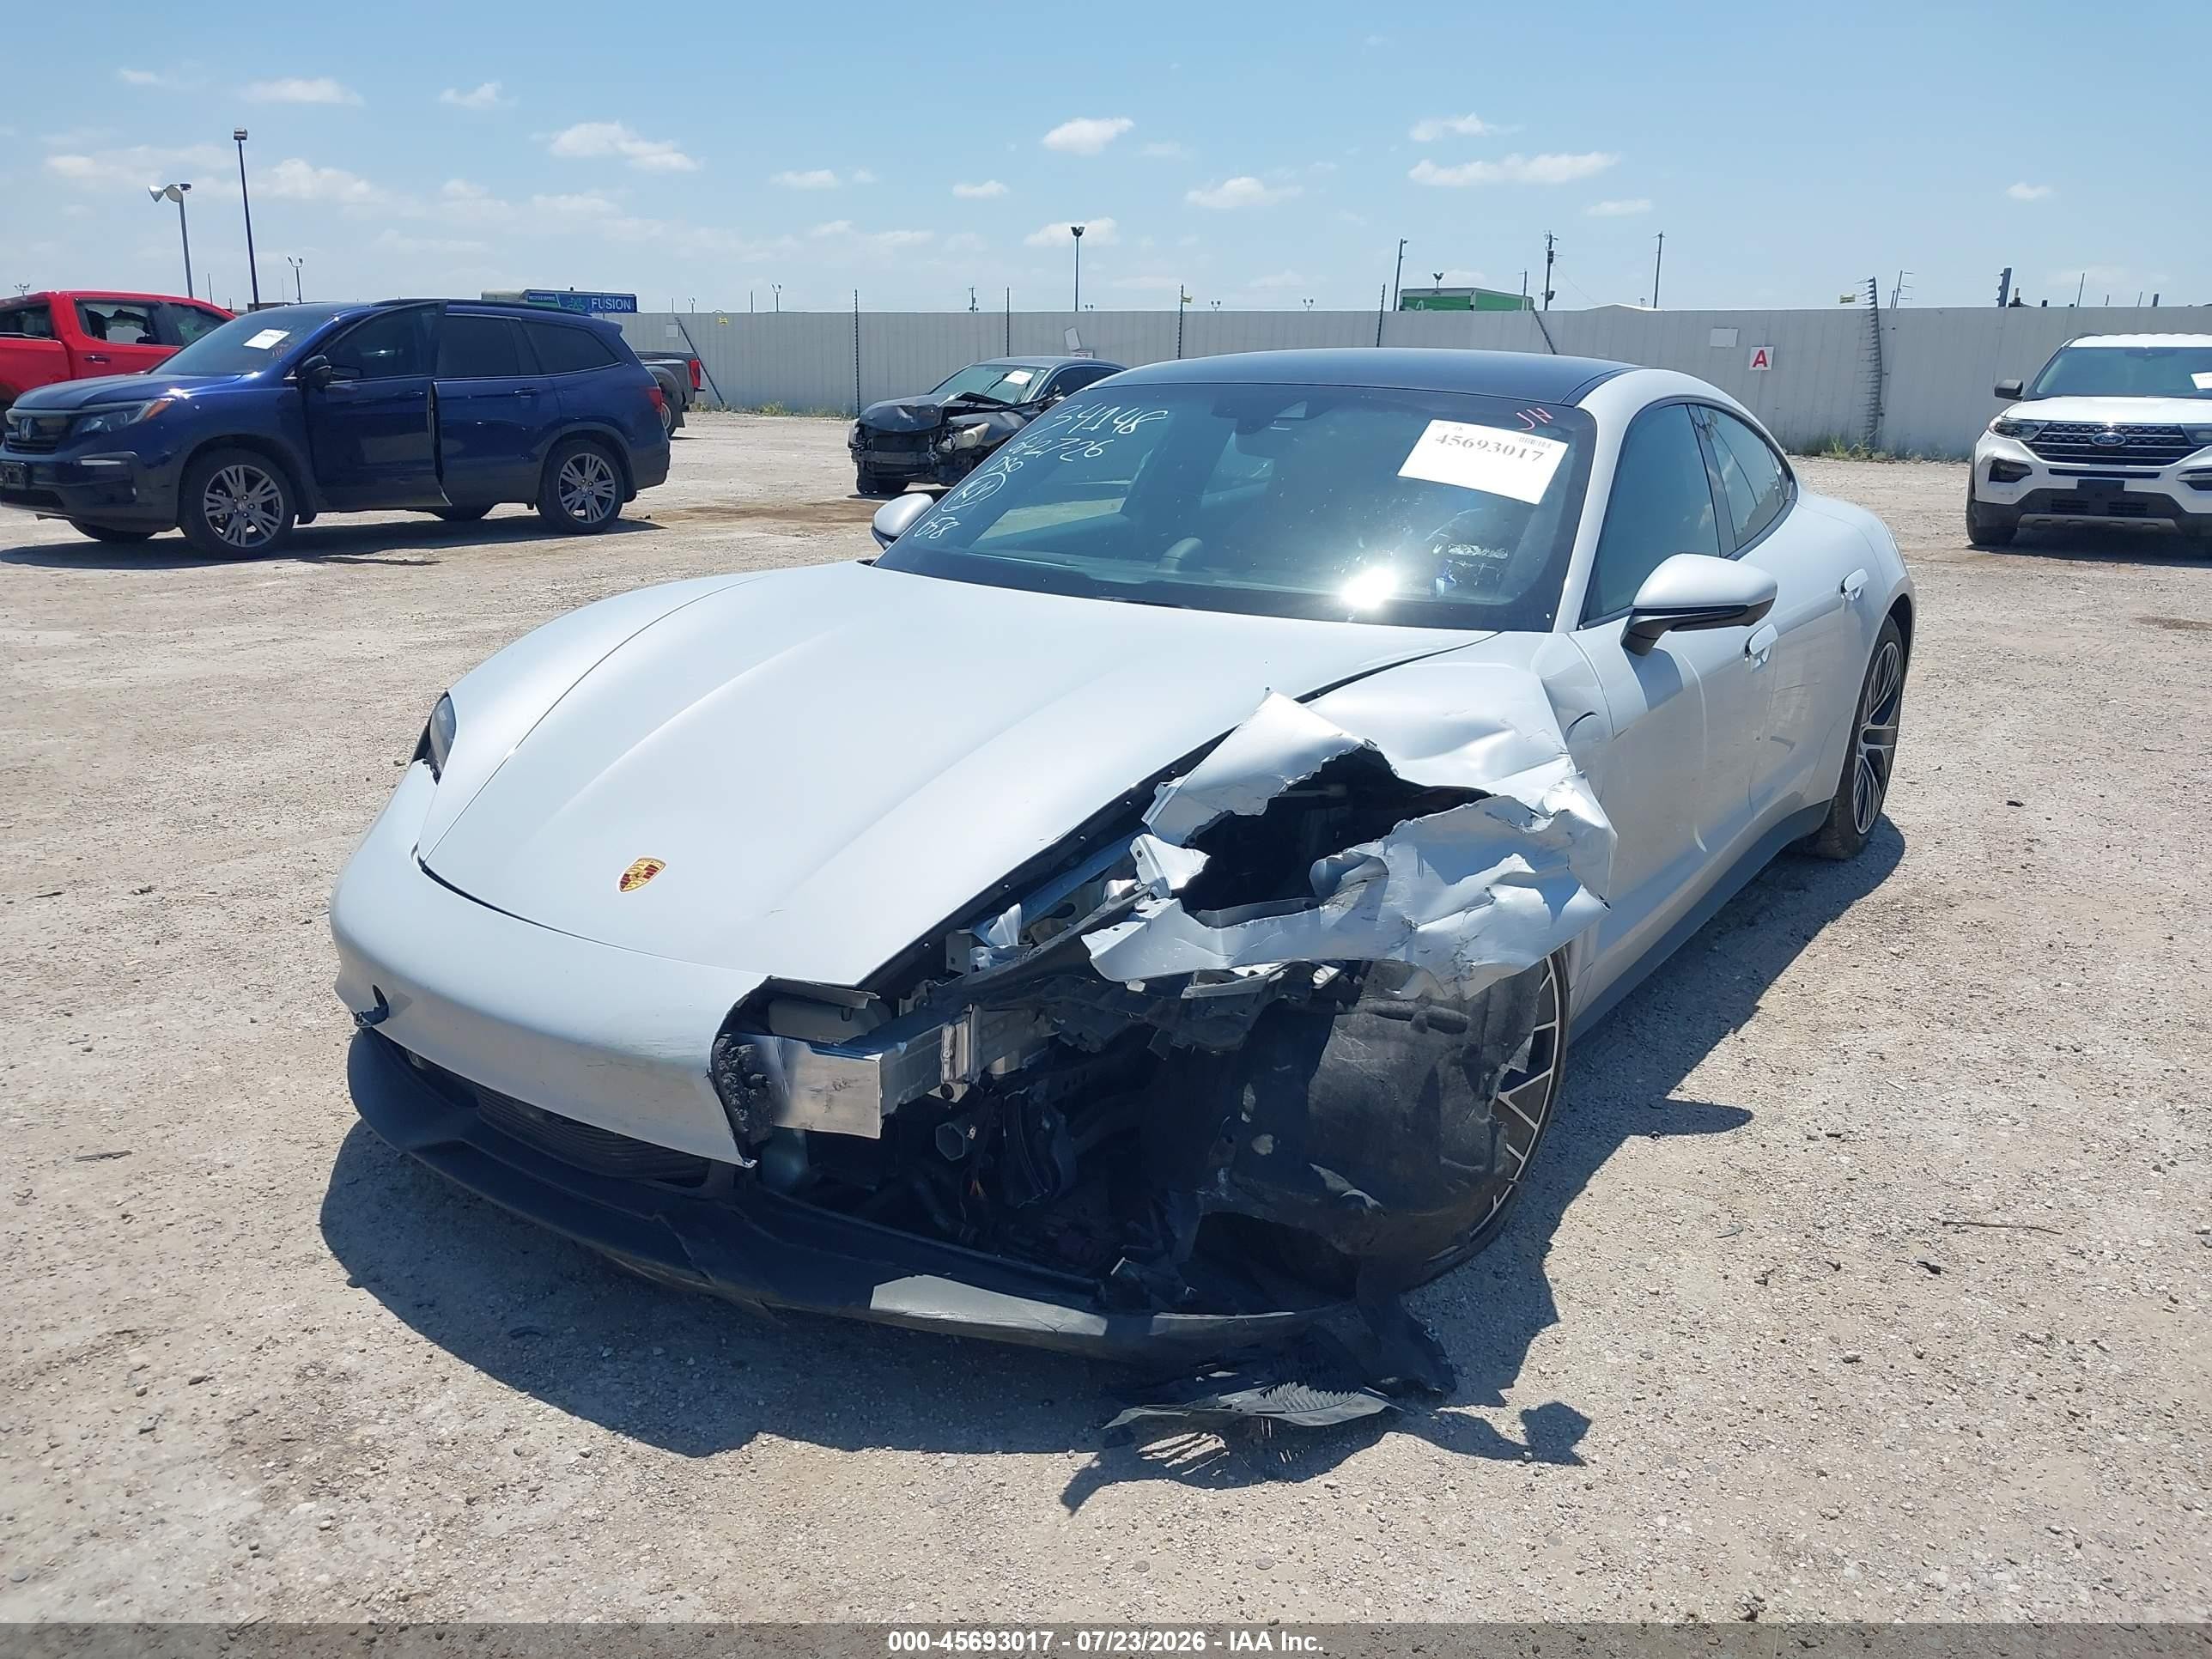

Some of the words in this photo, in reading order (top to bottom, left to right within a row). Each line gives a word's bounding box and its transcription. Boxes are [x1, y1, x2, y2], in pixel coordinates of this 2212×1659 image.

[591, 297, 631, 310] FUSION
[1752, 349, 1768, 368] A
[1435, 434, 1545, 462] 45693017
